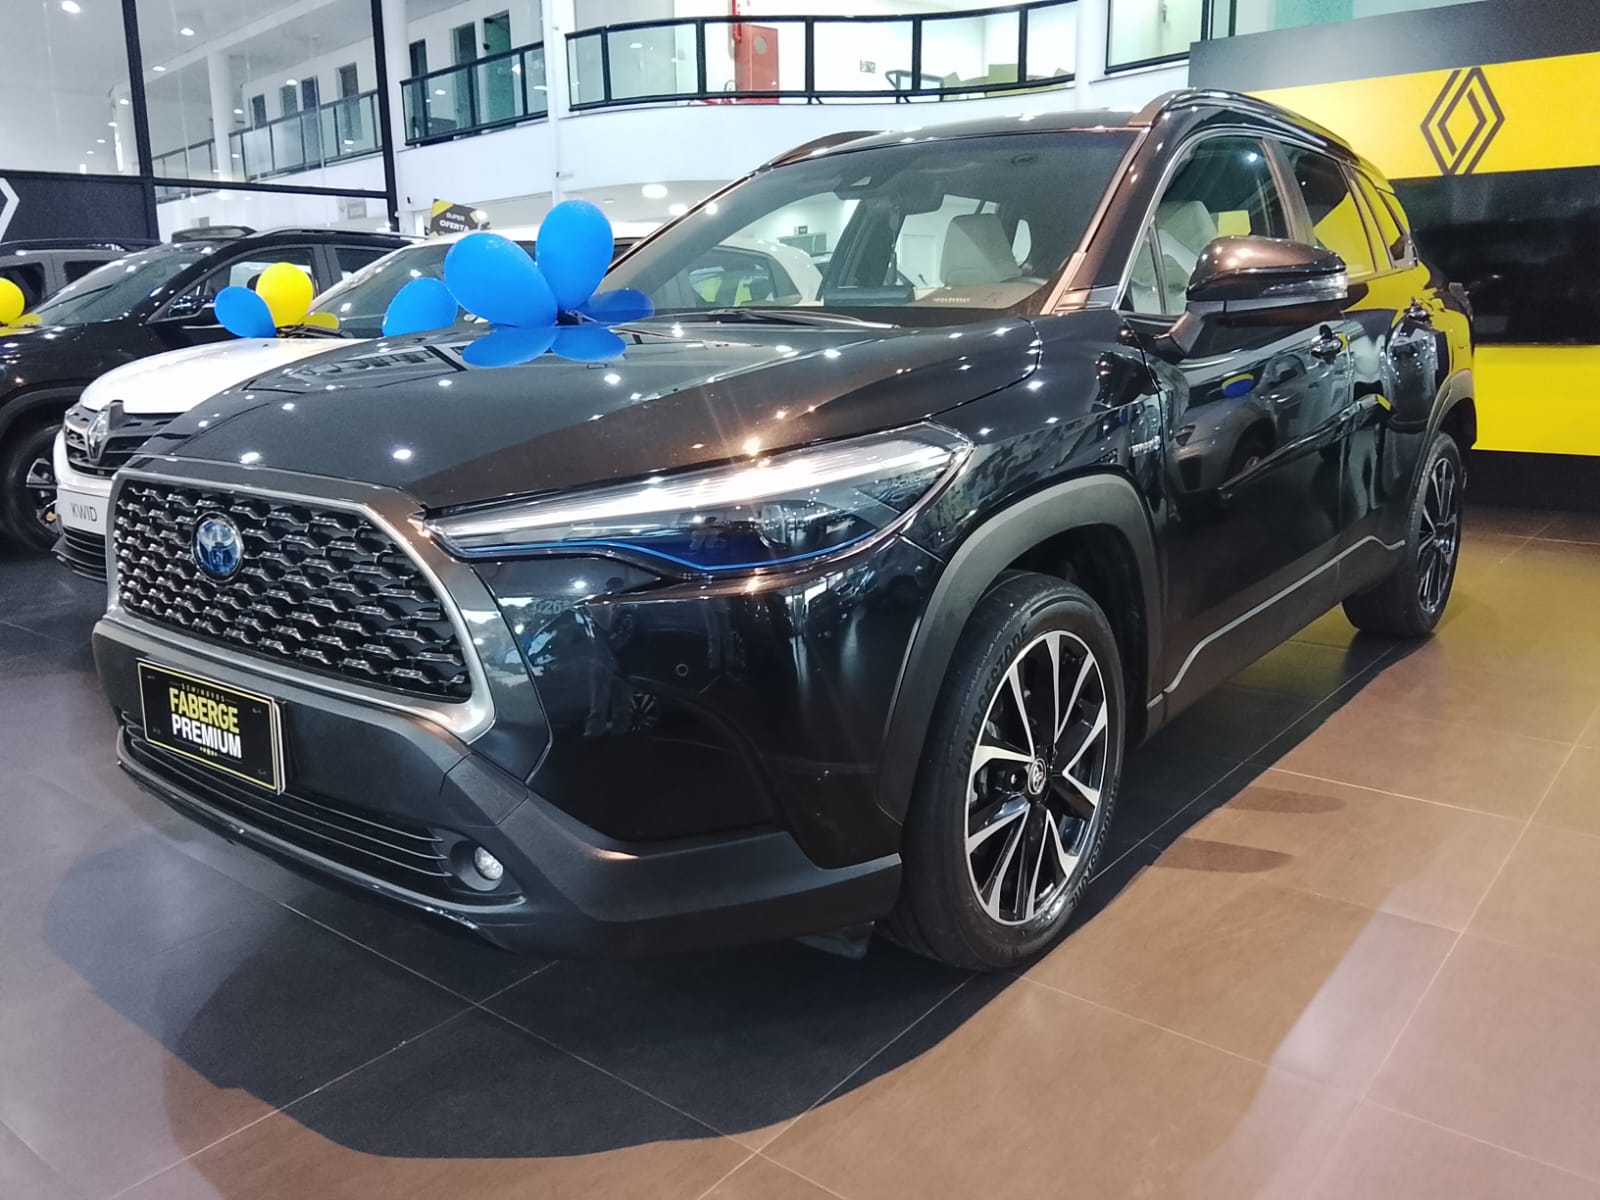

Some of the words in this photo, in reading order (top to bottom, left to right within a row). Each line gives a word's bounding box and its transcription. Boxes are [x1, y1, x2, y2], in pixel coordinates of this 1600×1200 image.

[439, 219, 469, 231] OFERTA
[169, 687, 240, 734] FABERGE
[171, 713, 242, 759] PREMIUM
